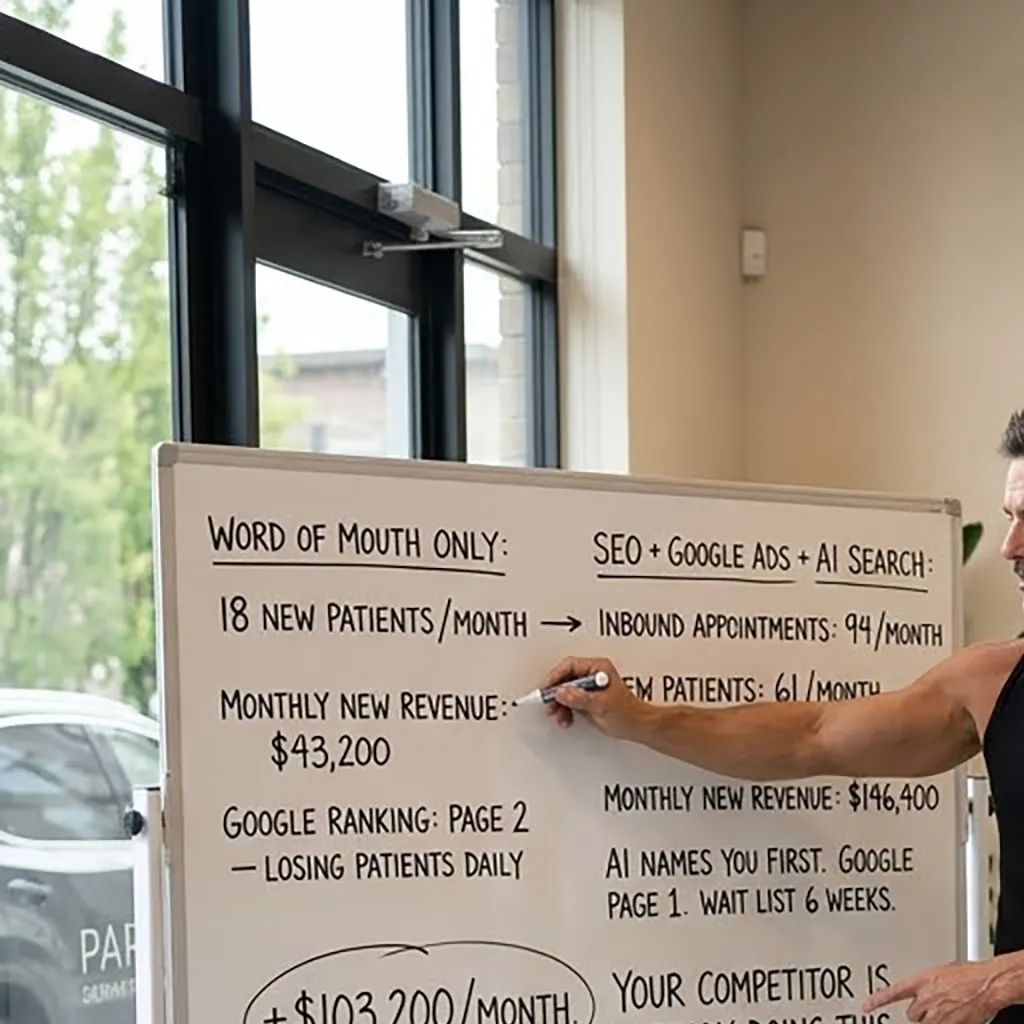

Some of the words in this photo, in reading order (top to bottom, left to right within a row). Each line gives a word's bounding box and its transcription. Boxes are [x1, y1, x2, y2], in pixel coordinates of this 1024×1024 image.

[208, 515, 285, 552] WORD
[297, 524, 326, 553] OF
[339, 523, 421, 558] MOUTH
[433, 529, 508, 563] ONLY:
[594, 532, 642, 565] SEO
[649, 544, 660, 558] +
[668, 536, 744, 568] GOOGLE
[752, 542, 791, 571] ADS
[798, 550, 810, 565] +
[816, 543, 837, 573] AI
[847, 545, 933, 580] SEARCH:
[221, 596, 249, 632] 18
[262, 604, 315, 631] NEW
[327, 598, 527, 644] PATIENTS/MONTH
[600, 609, 684, 638] INBOUND
[693, 613, 837, 642] APPOINTMENTS:
[845, 611, 942, 652] 94/MONTH
[221, 689, 329, 720] MONTHLY
[341, 693, 390, 719] NEW
[401, 692, 508, 722] REVENUE:
[662, 675, 765, 703] PATIENTS:
[271, 730, 391, 773] $43,200
[605, 784, 694, 812] MONTHLY
[703, 786, 744, 810] NEW
[751, 785, 841, 811] REVENUE:
[847, 782, 940, 816] $146,400
[223, 806, 316, 839] GOOGLE
[328, 806, 438, 835] RANKING:
[449, 804, 503, 833] PAGE
[513, 801, 529, 833] 2
[265, 853, 344, 882] LOSING
[356, 851, 455, 880] PATIENTS
[464, 850, 523, 880] DAILY
[606, 848, 629, 878] AI
[642, 849, 712, 876] NAMES
[721, 848, 758, 877] YOU
[767, 848, 826, 874] FIRST.
[839, 845, 913, 874] GOOGLE
[608, 891, 659, 919] PAGE
[668, 888, 688, 918] 1.
[700, 889, 749, 915] WAIT
[756, 888, 796, 913] LIST
[805, 886, 818, 914] 6
[826, 886, 895, 912] WEEKS.
[612, 970, 685, 1013] YOUR
[698, 965, 854, 1005] COMPETITOR
[868, 964, 890, 995] IS
